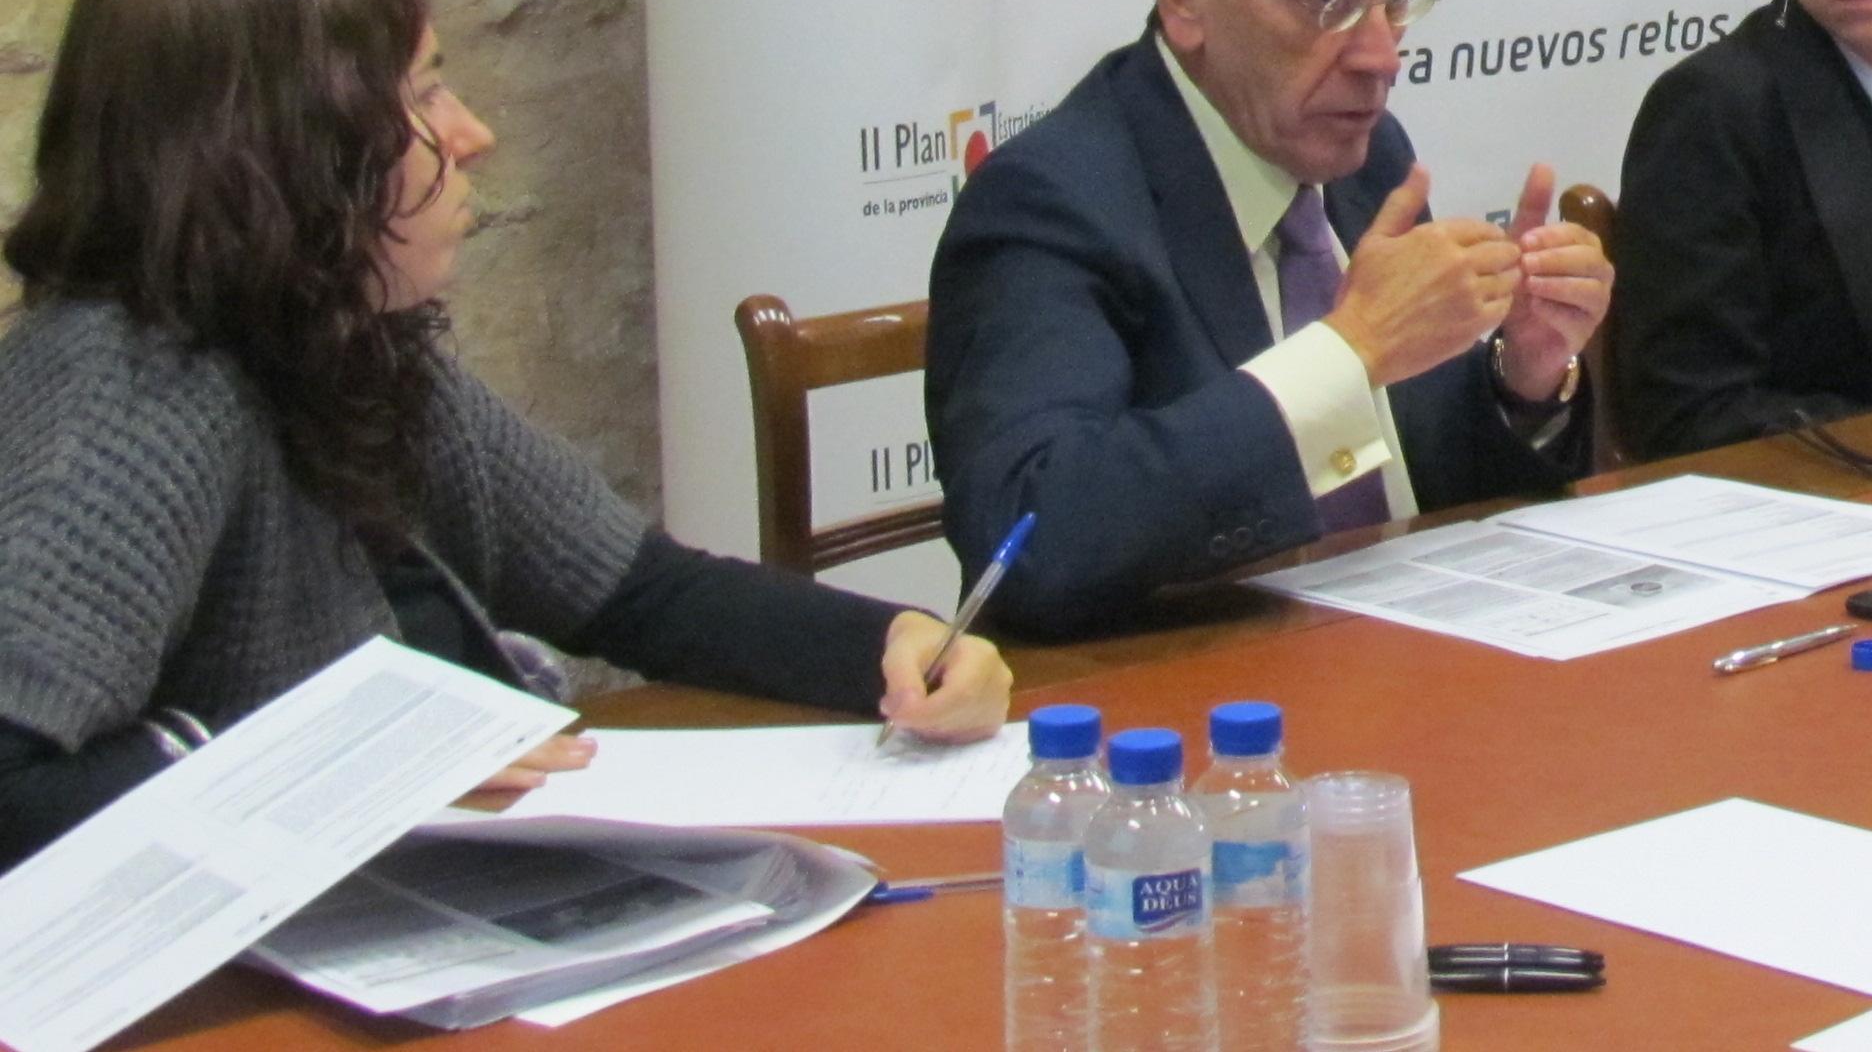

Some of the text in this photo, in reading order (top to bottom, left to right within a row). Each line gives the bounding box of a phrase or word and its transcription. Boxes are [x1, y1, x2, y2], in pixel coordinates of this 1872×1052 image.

[1449, 27, 1607, 81] nuevos
[1619, 10, 1729, 60] retos
[895, 122, 946, 169] Plan
[863, 191, 949, 217] de la provincia
[906, 440, 932, 486] Pl
[1140, 875, 1198, 896] AQUA
[1142, 894, 1197, 912] DEUS
